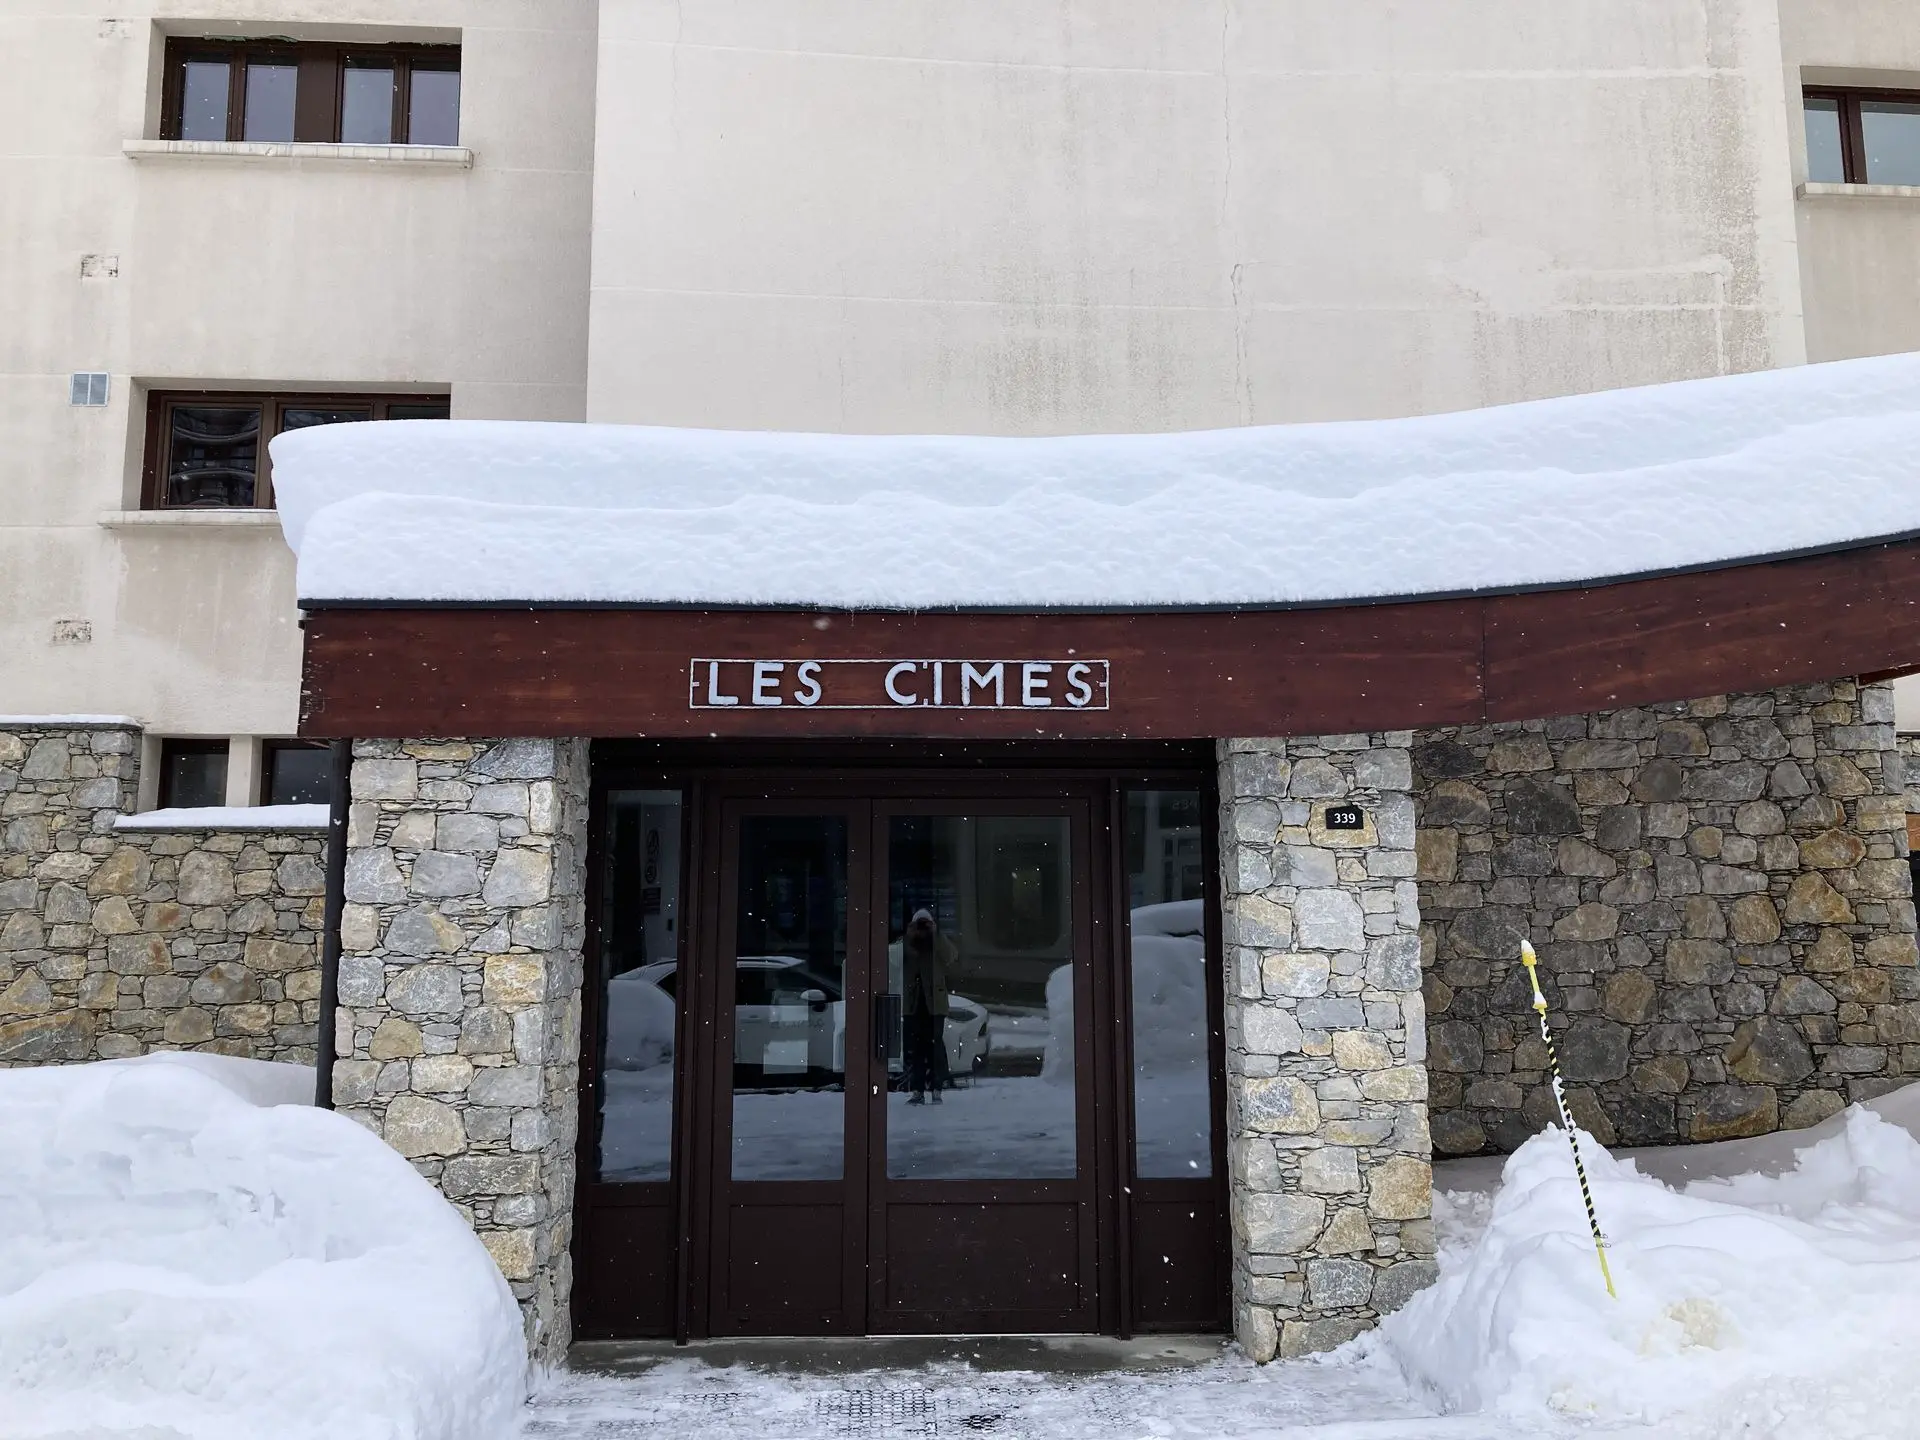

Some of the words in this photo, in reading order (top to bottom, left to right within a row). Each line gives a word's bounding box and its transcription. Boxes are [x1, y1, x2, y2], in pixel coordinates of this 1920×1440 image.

[708, 661, 822, 706] LES
[884, 661, 1092, 707] CIMES
[1333, 812, 1356, 824] 339
